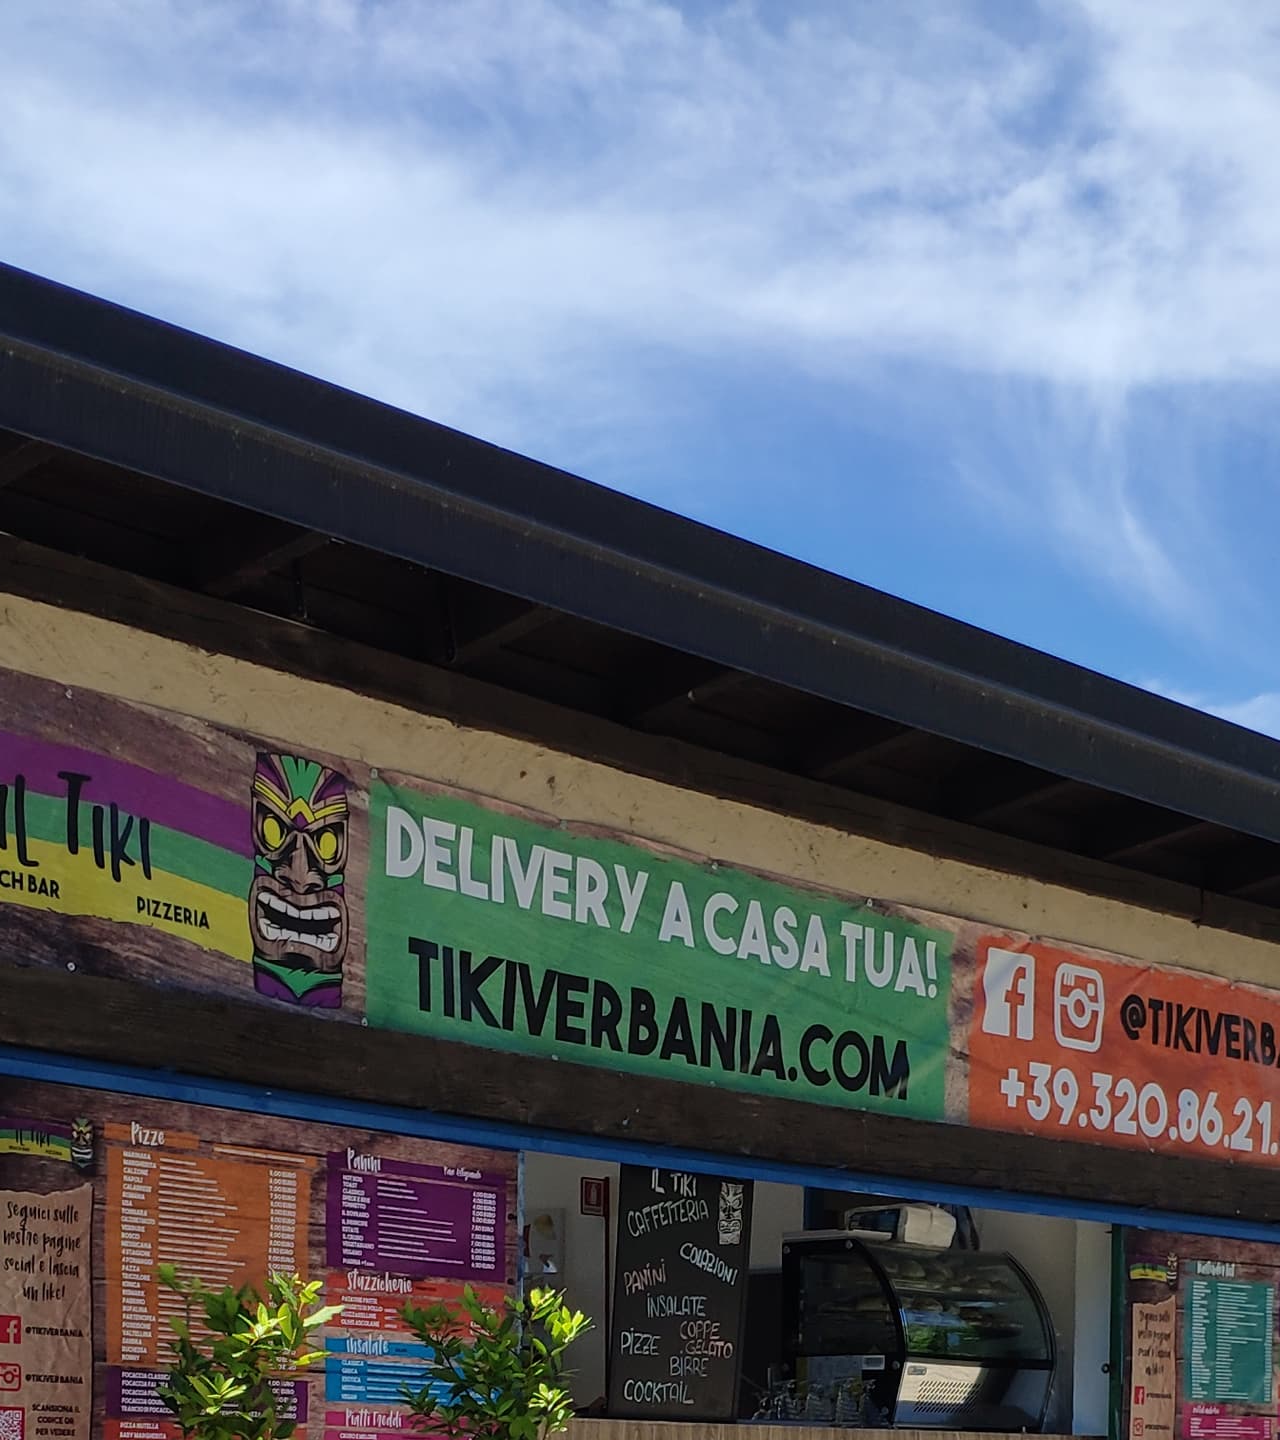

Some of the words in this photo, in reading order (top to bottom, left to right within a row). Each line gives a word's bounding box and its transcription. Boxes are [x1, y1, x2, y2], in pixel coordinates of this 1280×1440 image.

[27, 871, 61, 899] BAR
[136, 895, 210, 930] PIZZERIA
[385, 804, 648, 934] DELIVERY
[658, 881, 695, 949] A
[703, 892, 831, 977] CASA
[839, 920, 938, 1000] TUA!
[407, 936, 912, 1101] TIKIVERBANIA.COM
[131, 1120, 165, 1146] Pizze
[347, 1147, 381, 1174] Panini
[651, 1168, 665, 1194] IL
[7, 1201, 51, 1227] Seguici
[53, 1204, 79, 1224] sulle
[627, 1198, 709, 1237] CAFFETTERIA
[3, 1227, 39, 1246] nostre
[43, 1233, 81, 1257] pagine
[3, 1253, 35, 1274] social
[49, 1255, 79, 1278] lascia
[624, 1258, 667, 1296] PANINI
[679, 1242, 738, 1286] COLAZIONI
[42, 1282, 65, 1301] like!
[347, 1268, 413, 1294] Stuzzicherie
[646, 1293, 707, 1318] INSALATE
[620, 1328, 661, 1356] PIZZE
[679, 1320, 721, 1340] COPPE
[669, 1355, 709, 1377] BIRRE
[624, 1379, 694, 1405] COCKTAIL
[345, 1408, 370, 1427] Piatti
[372, 1410, 402, 1428] Freddi
